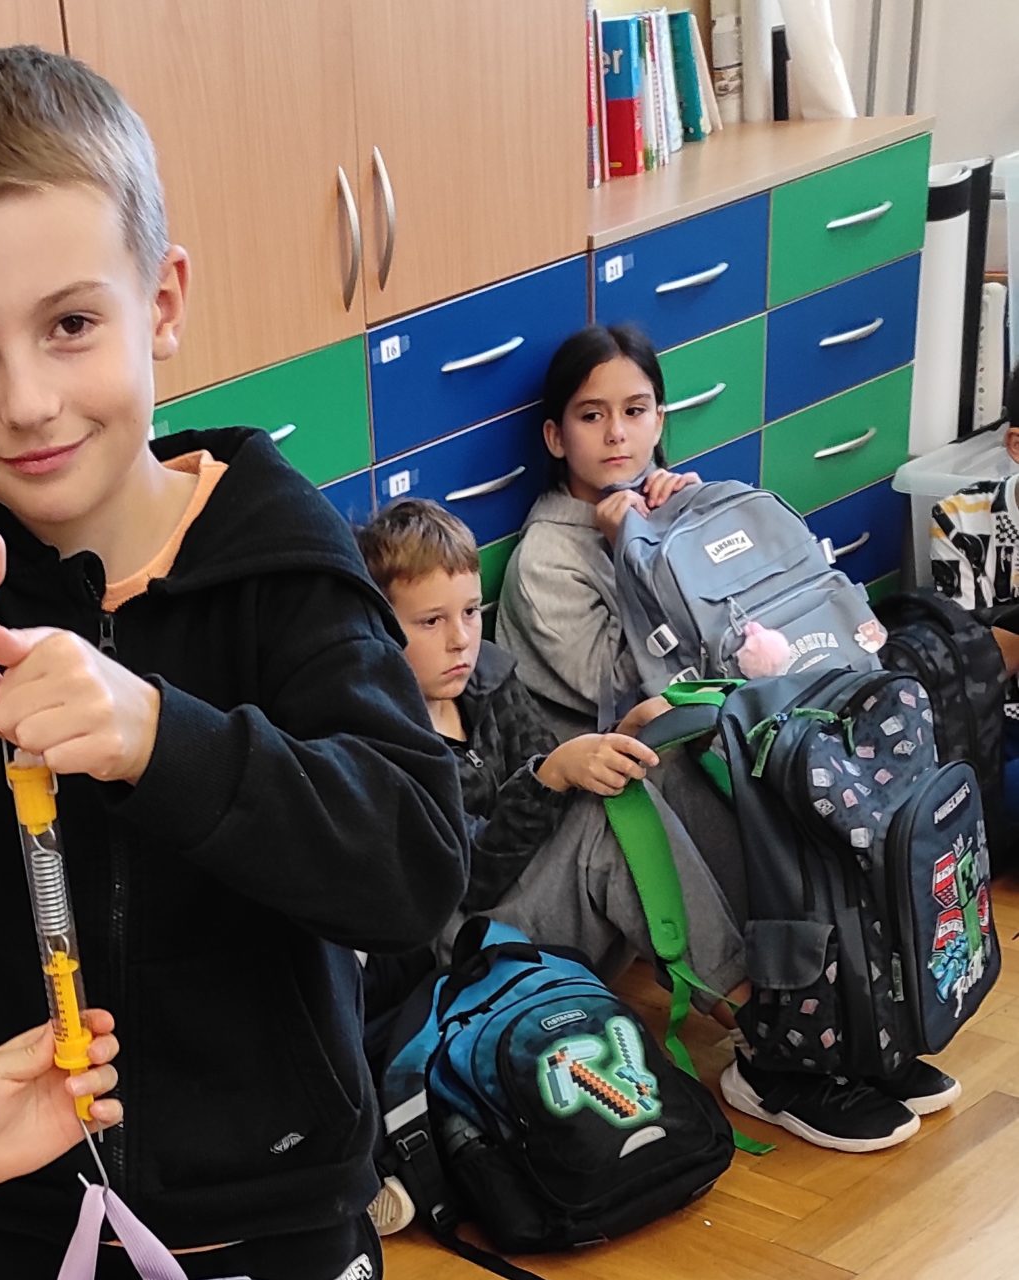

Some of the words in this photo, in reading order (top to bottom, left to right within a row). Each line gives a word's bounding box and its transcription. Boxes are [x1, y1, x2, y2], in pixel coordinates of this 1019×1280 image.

[609, 263, 620, 279] 21
[385, 344, 398, 359] 16
[395, 478, 406, 492] 17
